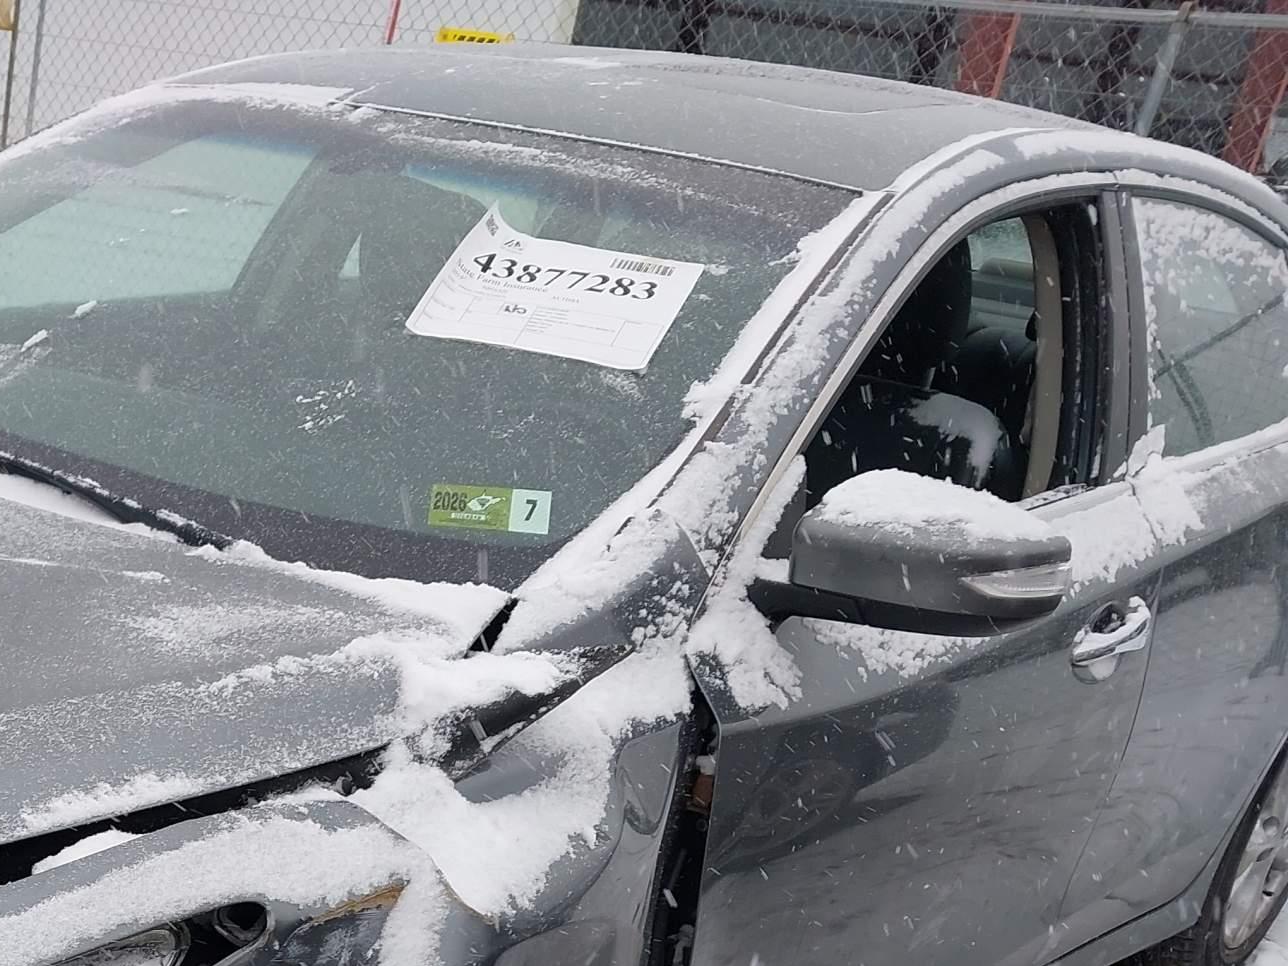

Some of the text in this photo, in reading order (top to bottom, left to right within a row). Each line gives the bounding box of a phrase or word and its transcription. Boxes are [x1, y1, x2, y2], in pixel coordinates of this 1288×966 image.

[473, 253, 658, 300] 43877283
[476, 273, 502, 287] Farm
[503, 280, 548, 293] Insurance
[432, 491, 538, 521] 2026 7
